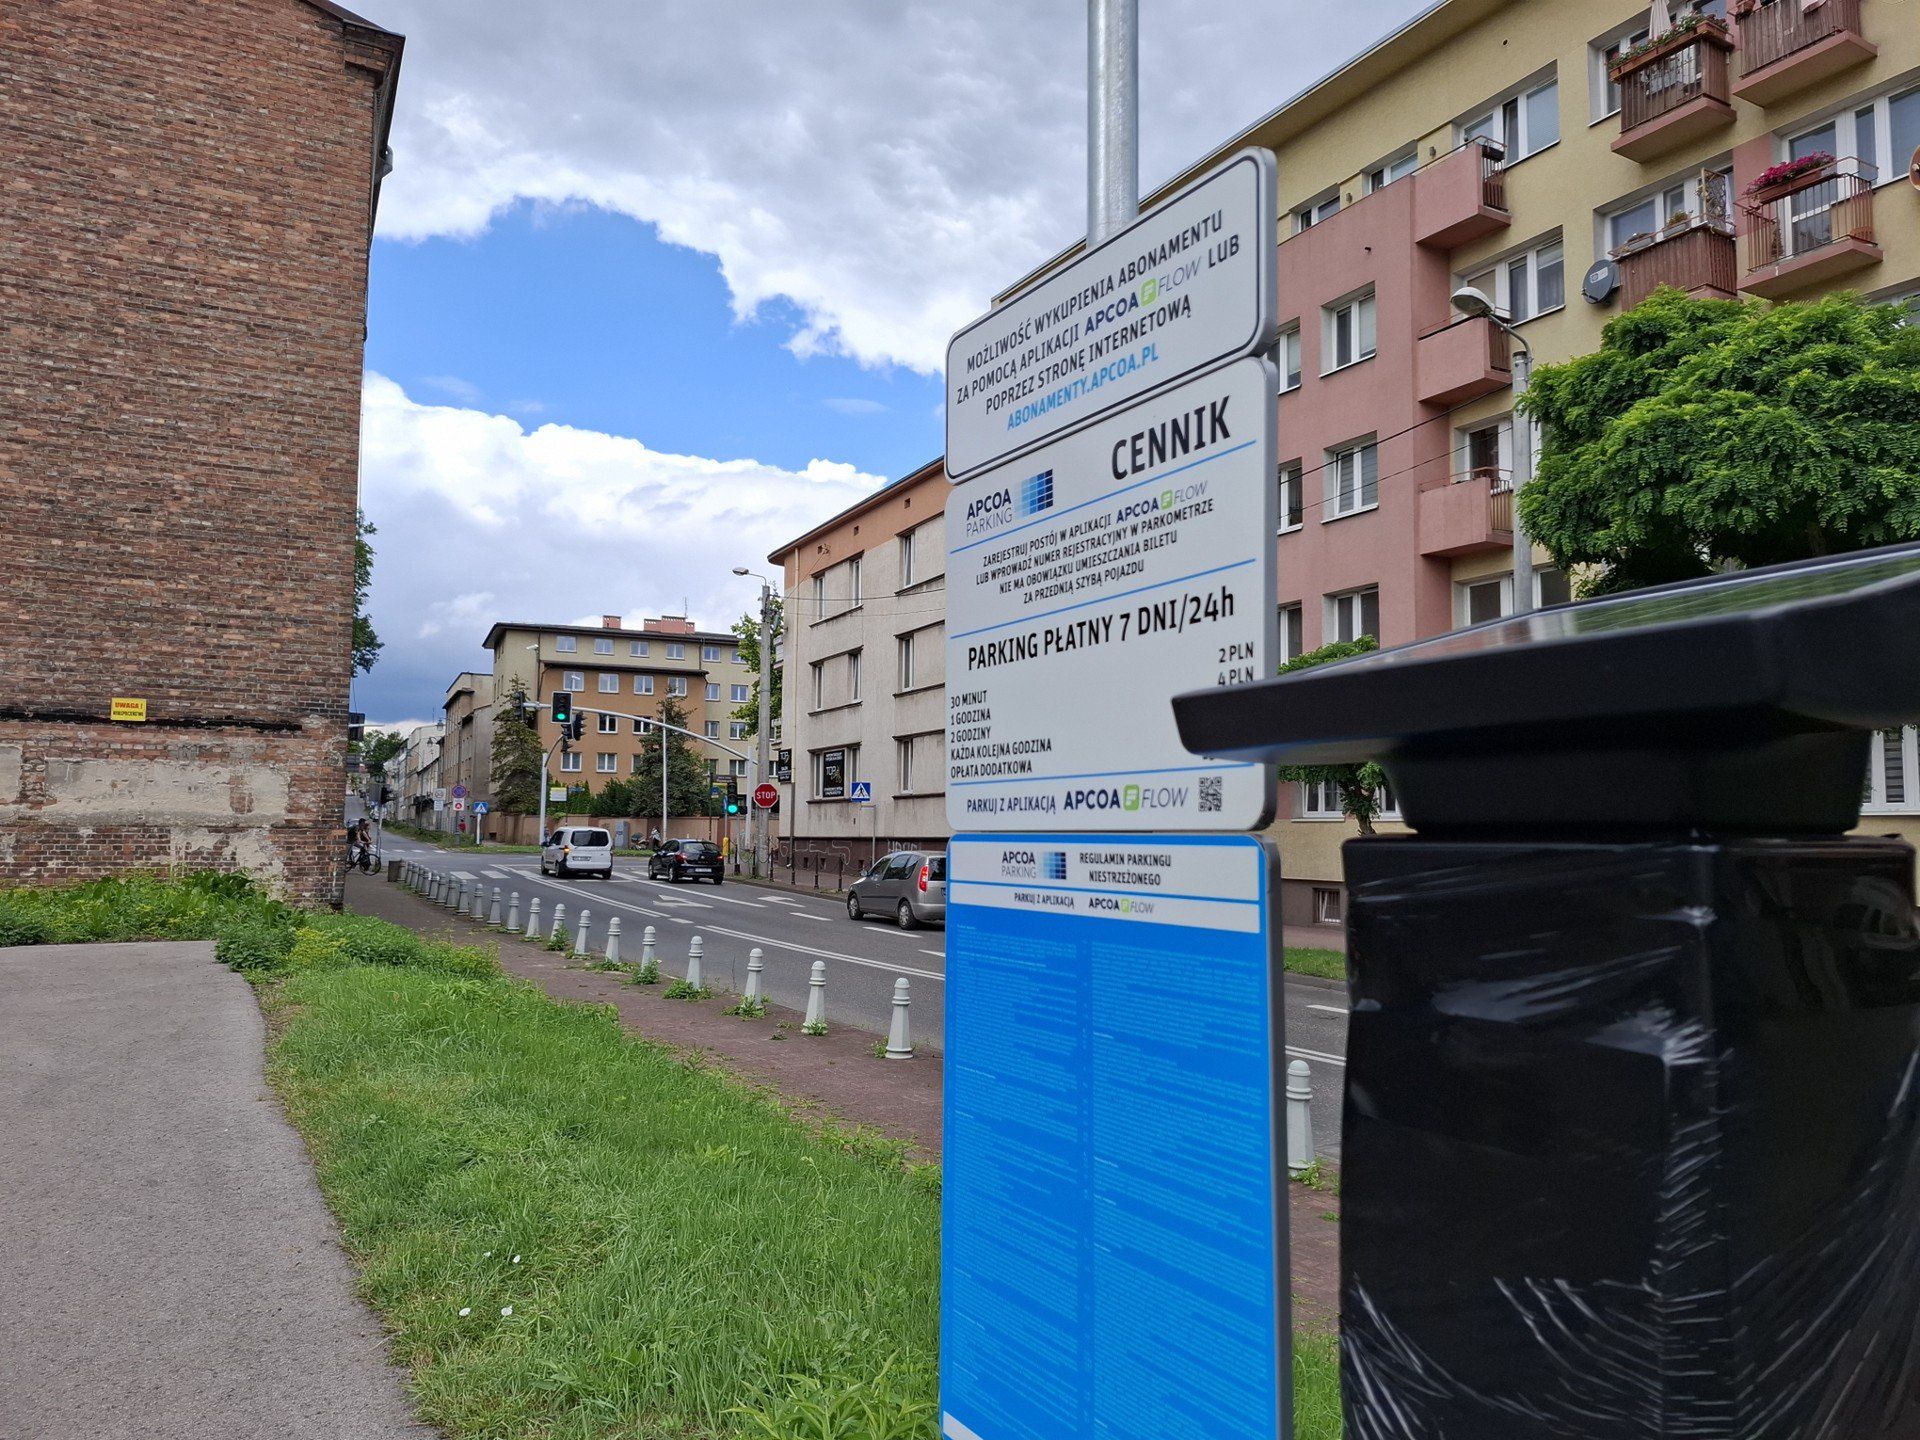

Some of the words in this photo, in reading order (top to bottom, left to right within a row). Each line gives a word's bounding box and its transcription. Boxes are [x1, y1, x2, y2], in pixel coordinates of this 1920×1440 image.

[967, 318, 1031, 373] MOŻLIWOŚĆ
[1034, 275, 1113, 334] WYKUPIENIA
[1118, 210, 1222, 288] ABONAMENTU
[956, 387, 969, 405] ZA
[972, 361, 1017, 393] POMOCĄ
[1020, 324, 1078, 371] APLIKACJI
[1085, 293, 1139, 335] APCOA
[1158, 258, 1202, 296] FLOW
[1208, 234, 1239, 268] LUB
[986, 375, 1035, 414] POPRZEZ
[1038, 350, 1085, 388] STRONĘ
[1089, 294, 1192, 362] INTERNETOWĄ
[1007, 345, 1158, 431] ABONAMENTY.APCOA.PL
[1111, 395, 1230, 480] CENNIK
[967, 489, 1011, 521] APCOA
[966, 507, 1012, 537] PARKING
[983, 545, 1028, 567] ZAREJESTRUJ
[1030, 532, 1058, 555] POSTÓJ
[1059, 530, 1067, 542] W
[1069, 514, 1111, 538] APLIKACJI
[1117, 498, 1158, 523] APCOA
[1174, 481, 1208, 505] FLOW
[976, 571, 988, 585] LUB
[990, 558, 1032, 580] WPROWADŹ
[1034, 550, 1060, 568] NUMER
[1063, 528, 1127, 562] REJESTRACYJNY
[1129, 525, 1138, 536] W
[1141, 499, 1213, 533] PARKOMETRZE
[999, 581, 1011, 594] NIE
[1014, 576, 1024, 589] MA
[1026, 562, 1073, 587] OBOWIĄZKU
[1075, 544, 1140, 573] UMIESZCZANIA
[1143, 530, 1177, 553] BILETU
[1023, 591, 1033, 604] ZA
[1035, 578, 1074, 602] PRZEDNIĄ
[1076, 569, 1102, 591] SZYBĄ
[1105, 560, 1144, 582] POJAZDU
[968, 634, 1037, 671] PARKING
[1044, 615, 1113, 656] PŁATNY
[1120, 613, 1130, 641] 7
[1138, 586, 1234, 635] DNI/24h
[1219, 649, 1227, 662] 2
[1229, 642, 1253, 661] PLN
[1218, 672, 1225, 686] 4
[1229, 667, 1253, 684] PLN
[951, 696, 960, 708] 30
[961, 691, 987, 706] MINUT
[951, 714, 955, 725] 1
[956, 709, 990, 724] GODZINA
[951, 732, 955, 743] 2
[956, 727, 991, 742] GODZINY
[951, 744, 975, 761] KAŻDA
[976, 742, 1010, 759] KOLEJNA
[1012, 739, 1051, 755] GODZINA
[826, 766, 836, 775] TOP
[951, 764, 979, 778] OPŁATA
[980, 760, 1032, 776] DODATKOWA
[756, 791, 776, 799] STOP
[967, 798, 998, 815] PARKUJ
[999, 798, 1005, 811] Z
[1007, 796, 1056, 815] APLIKACJĄ
[1064, 788, 1120, 810] APCOA
[1141, 788, 1188, 808] FLOW
[1002, 851, 1035, 864] APCOA
[1080, 853, 1125, 866] REGULAMIN
[1127, 854, 1171, 867] PARKINGU
[1001, 866, 1036, 878] PARKING
[1089, 869, 1161, 885] NIESTRZEŻONEGO
[1014, 893, 1035, 906] PARKUJ
[1036, 895, 1041, 904] Z
[1089, 898, 1119, 911] APCOA
[1130, 901, 1154, 914] FLOW
